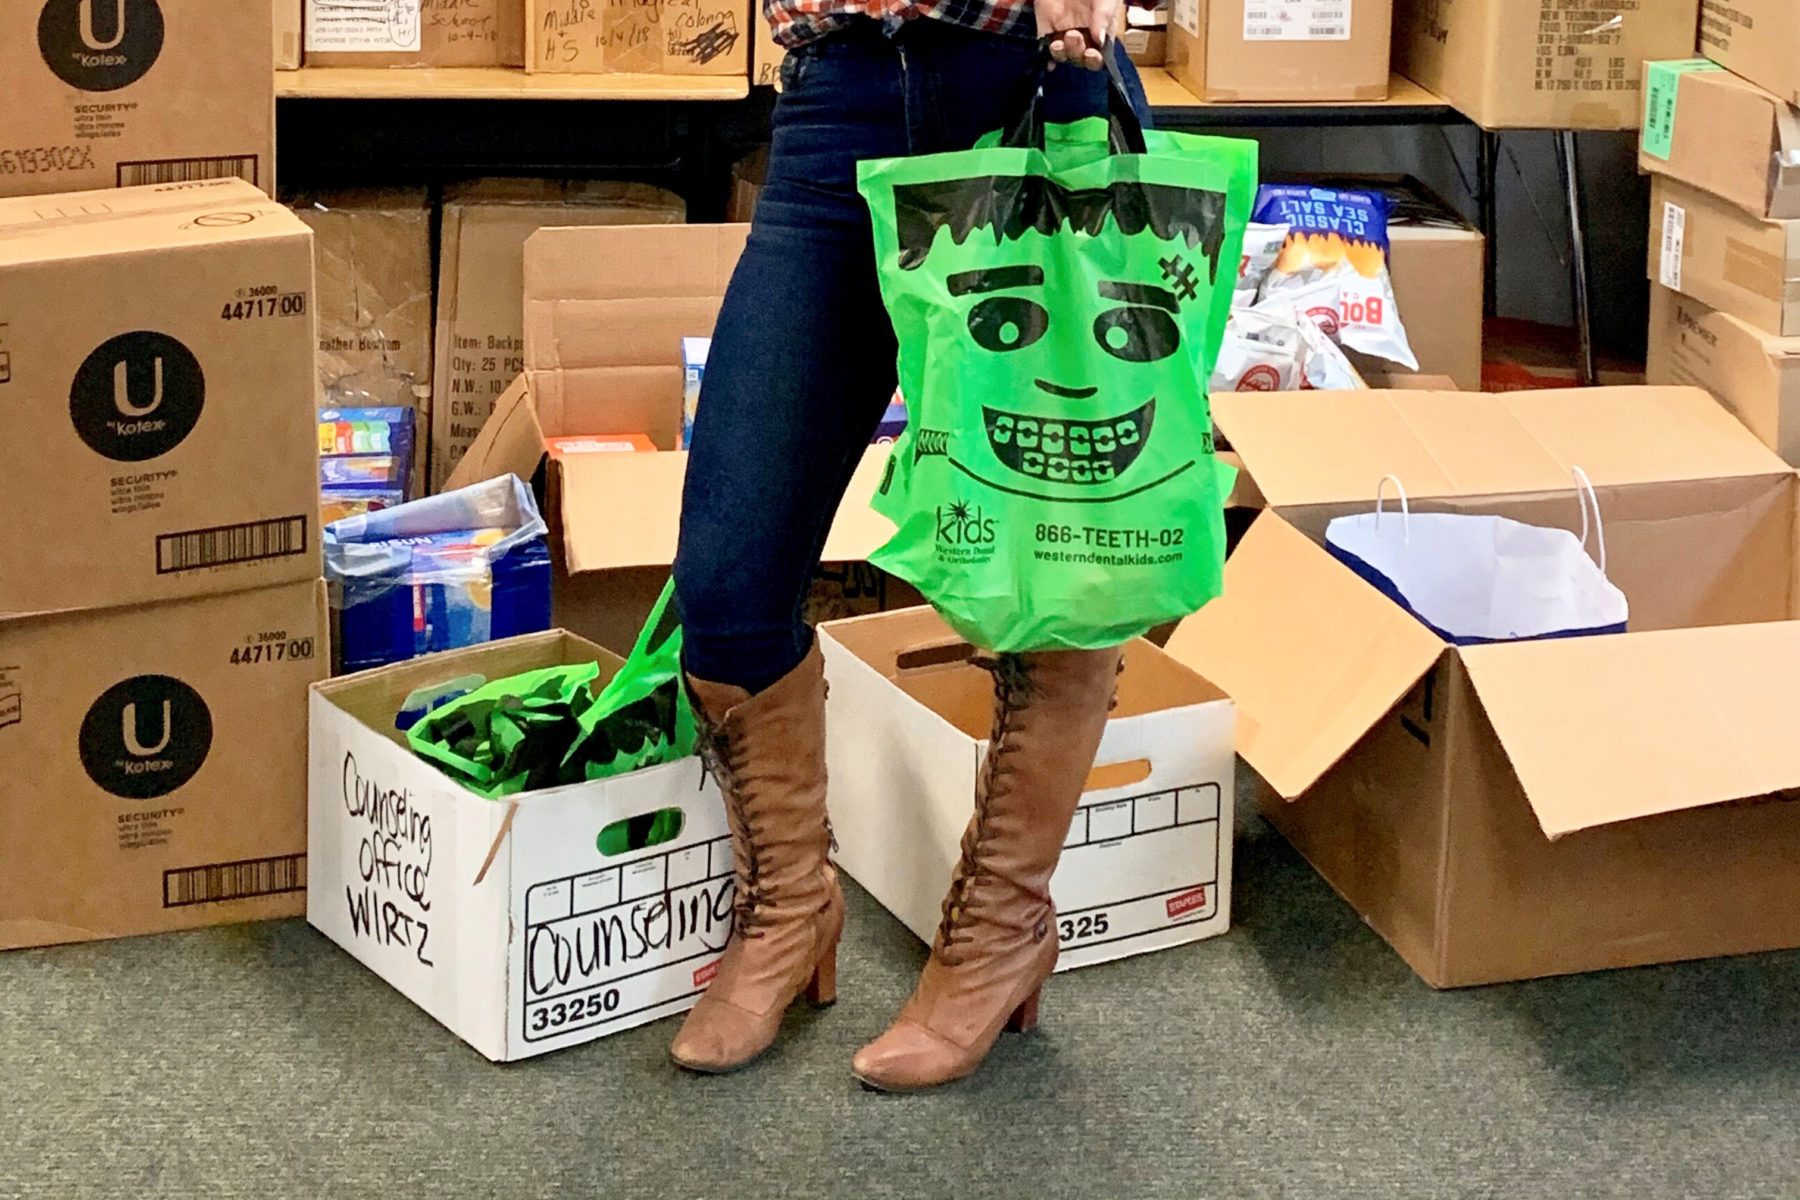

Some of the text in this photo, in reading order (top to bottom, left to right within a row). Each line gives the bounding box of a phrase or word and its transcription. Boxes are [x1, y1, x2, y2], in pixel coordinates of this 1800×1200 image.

[543, 9, 596, 32] Middle
[81, 53, 125, 68] Kotex
[1279, 200, 1370, 223] SEA SALT
[1284, 213, 1365, 235] CLASSIC
[453, 334, 482, 349] Item:
[452, 356, 476, 374] Qty:
[481, 357, 496, 372] 25
[113, 356, 164, 417] U
[116, 419, 164, 437] Kotex
[936, 502, 996, 545] kids
[1035, 523, 1185, 549] 866-TEETH-02
[1033, 549, 1184, 567] westerndentalkids.com
[122, 699, 172, 757] U
[125, 760, 174, 775] Kotex
[342, 750, 434, 879] Counseling
[358, 830, 432, 912] Office
[1167, 891, 1205, 913] STAPLES
[346, 885, 434, 968] WIRTZ
[528, 876, 736, 996] Counseling
[1058, 912, 1109, 942] 325
[531, 988, 621, 1032] 33250
